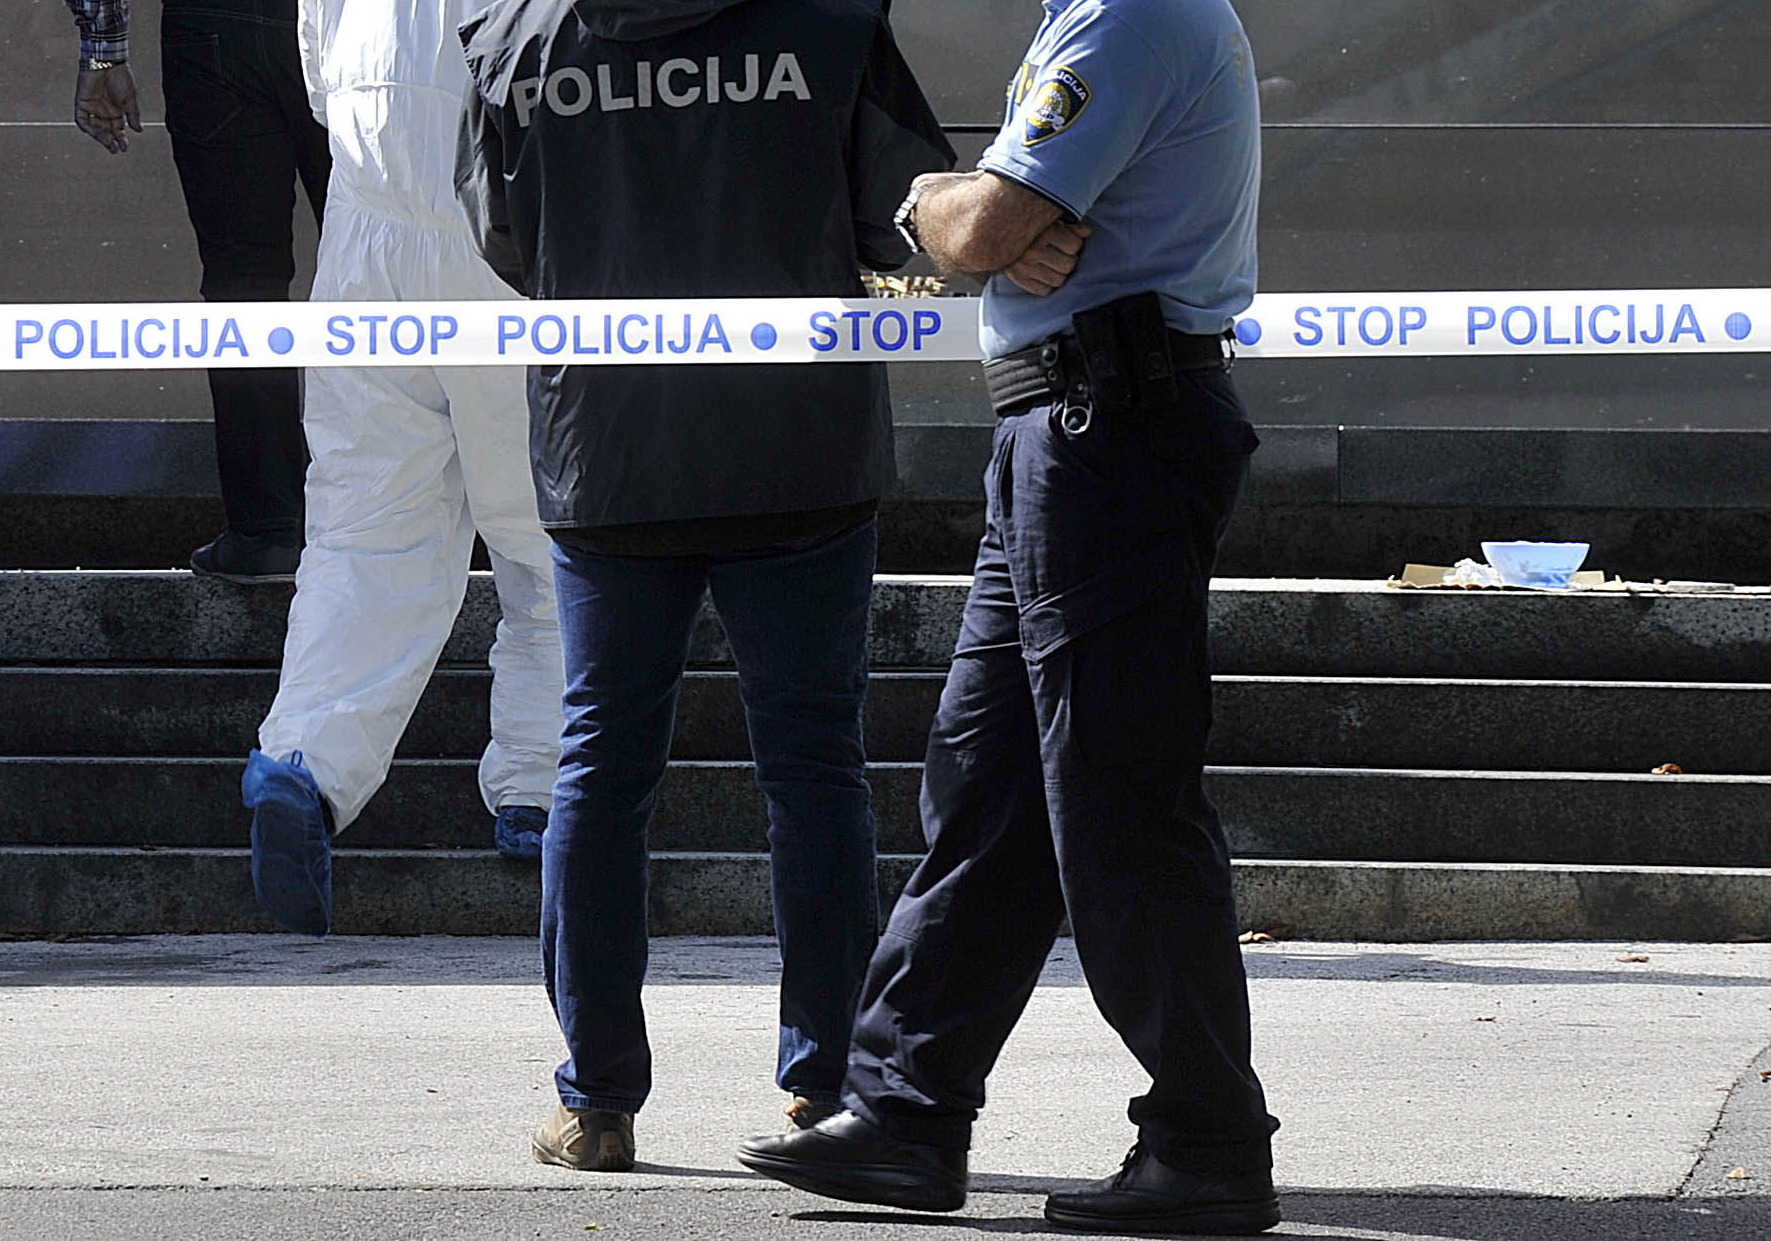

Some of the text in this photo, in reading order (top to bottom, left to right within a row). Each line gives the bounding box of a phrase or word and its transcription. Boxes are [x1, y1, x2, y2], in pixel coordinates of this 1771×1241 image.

[510, 52, 813, 128] POLICIJA
[1052, 70, 1087, 101] ICIJA
[15, 318, 249, 360] POLICIJA
[326, 315, 459, 356] STOP
[498, 313, 733, 355] POLICIJA
[809, 310, 942, 352] STOP
[1294, 305, 1427, 347] STOP
[1467, 303, 1706, 346] POLICIJA
